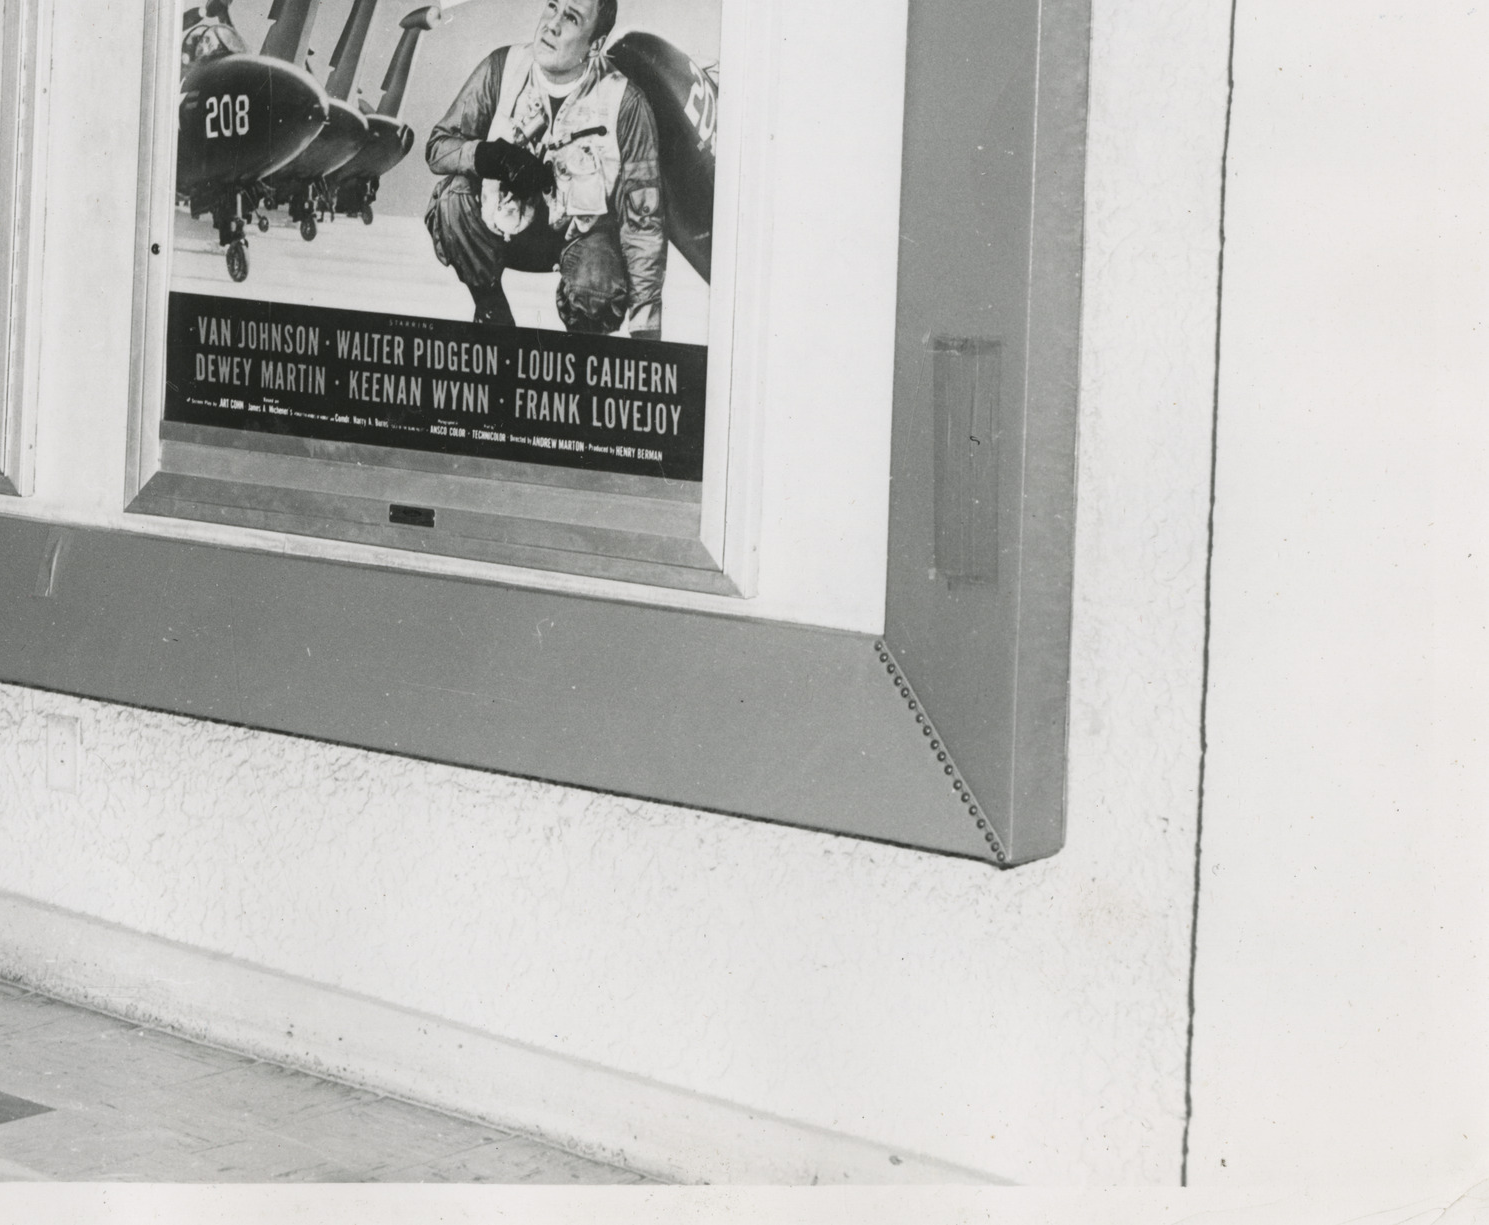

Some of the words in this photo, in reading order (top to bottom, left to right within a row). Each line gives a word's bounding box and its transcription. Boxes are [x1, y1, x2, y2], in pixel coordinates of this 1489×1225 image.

[205, 93, 250, 139] 208
[683, 59, 716, 156] 20
[198, 316, 232, 347] VAN
[238, 320, 320, 356] JOHNSON
[337, 329, 405, 366] WALTER
[413, 338, 498, 376] PIDGEON
[517, 348, 576, 385] LOUIS
[586, 355, 678, 395] CALHERN
[389, 319, 434, 330] STARRING
[195, 353, 252, 386] DEWEY
[261, 359, 326, 396] MARTIN
[349, 370, 422, 407] KEENAN
[432, 379, 489, 414] WYNN
[515, 388, 580, 425] FRANK
[592, 395, 682, 436] LOVEJOY
[218, 398, 229, 409] ART
[230, 399, 244, 410] COHN
[430, 425, 447, 436] ANSCO
[449, 427, 466, 438] COLOR
[472, 429, 506, 442] TECHNICOLOR
[532, 436, 557, 449] ANDREW
[558, 439, 585, 452] MARTON
[615, 445, 636, 459] HENRY
[637, 448, 663, 461] BERMAN
